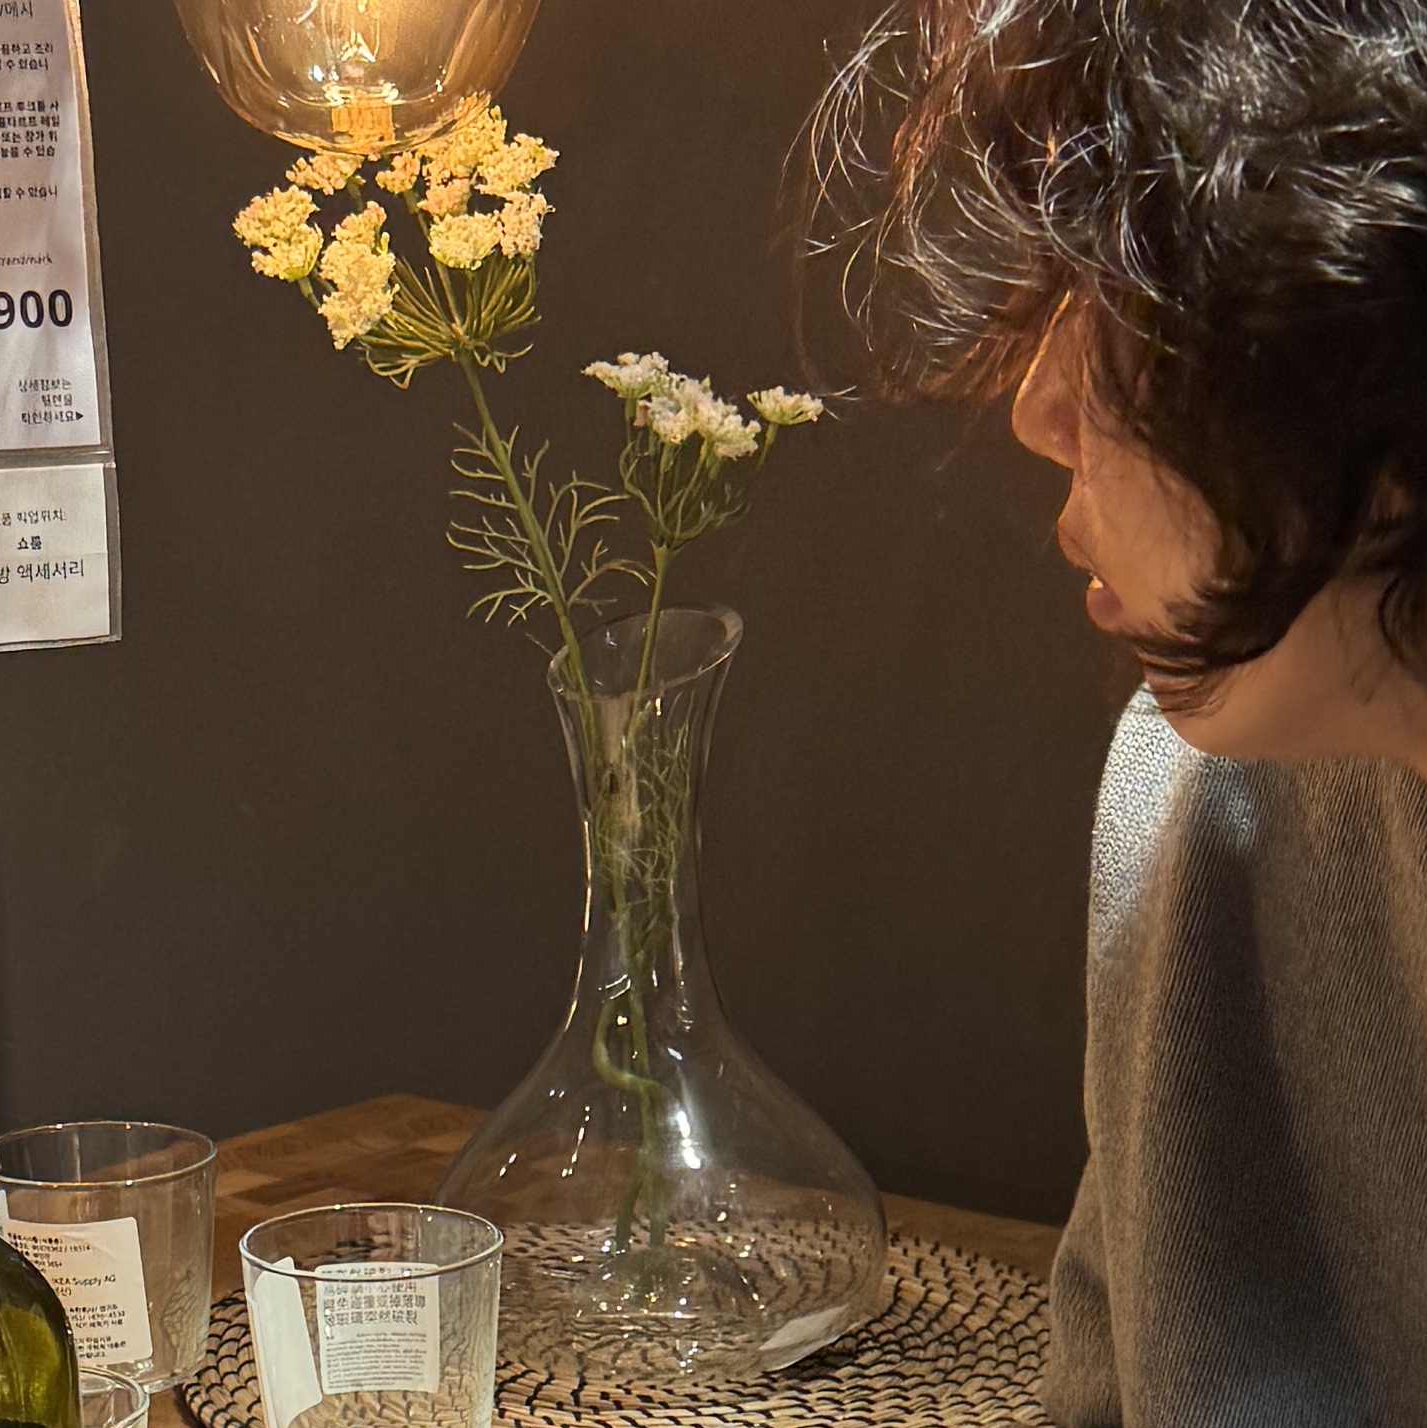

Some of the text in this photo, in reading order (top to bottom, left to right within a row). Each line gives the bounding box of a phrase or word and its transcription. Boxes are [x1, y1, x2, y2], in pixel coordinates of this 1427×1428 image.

[17, 559, 84, 582] 액세서리
[73, 1276, 102, 1287] Supply
[104, 1275, 117, 1283] AG
